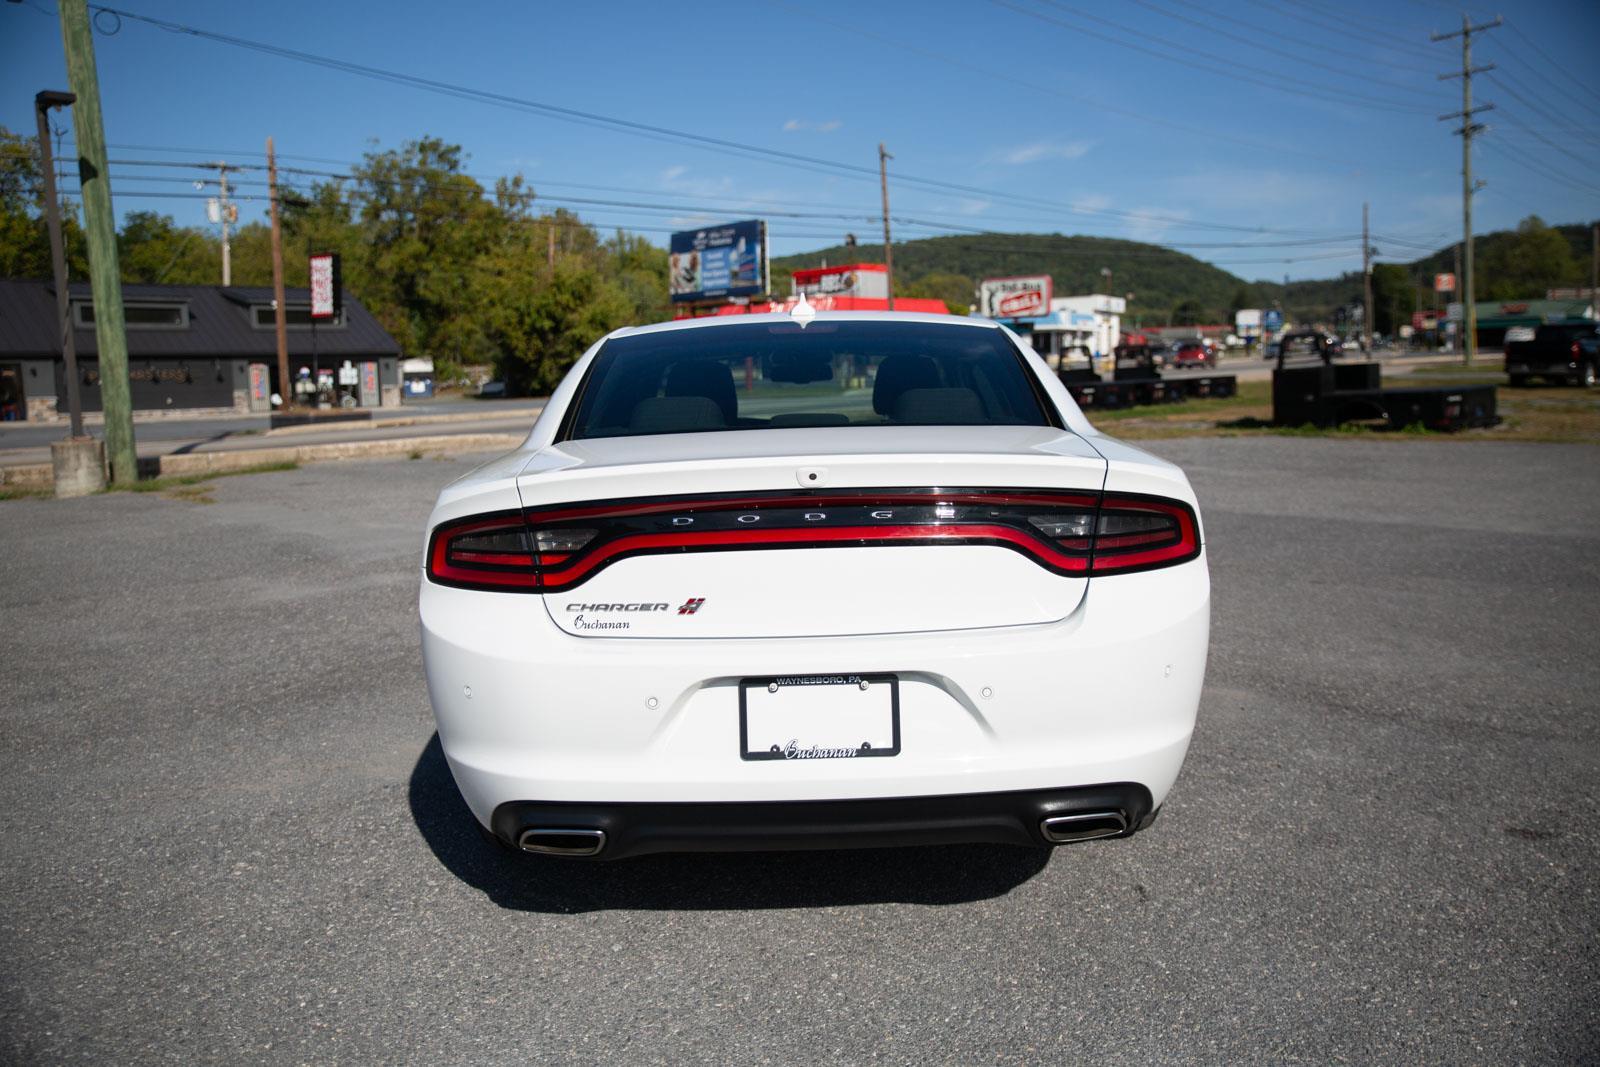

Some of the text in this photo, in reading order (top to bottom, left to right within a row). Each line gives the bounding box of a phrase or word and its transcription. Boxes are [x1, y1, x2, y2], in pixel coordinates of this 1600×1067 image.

[566, 603, 670, 613] CHARGER
[574, 614, 630, 630] Buchanan
[848, 675, 862, 683] PA
[783, 738, 858, 759] Buchanan
